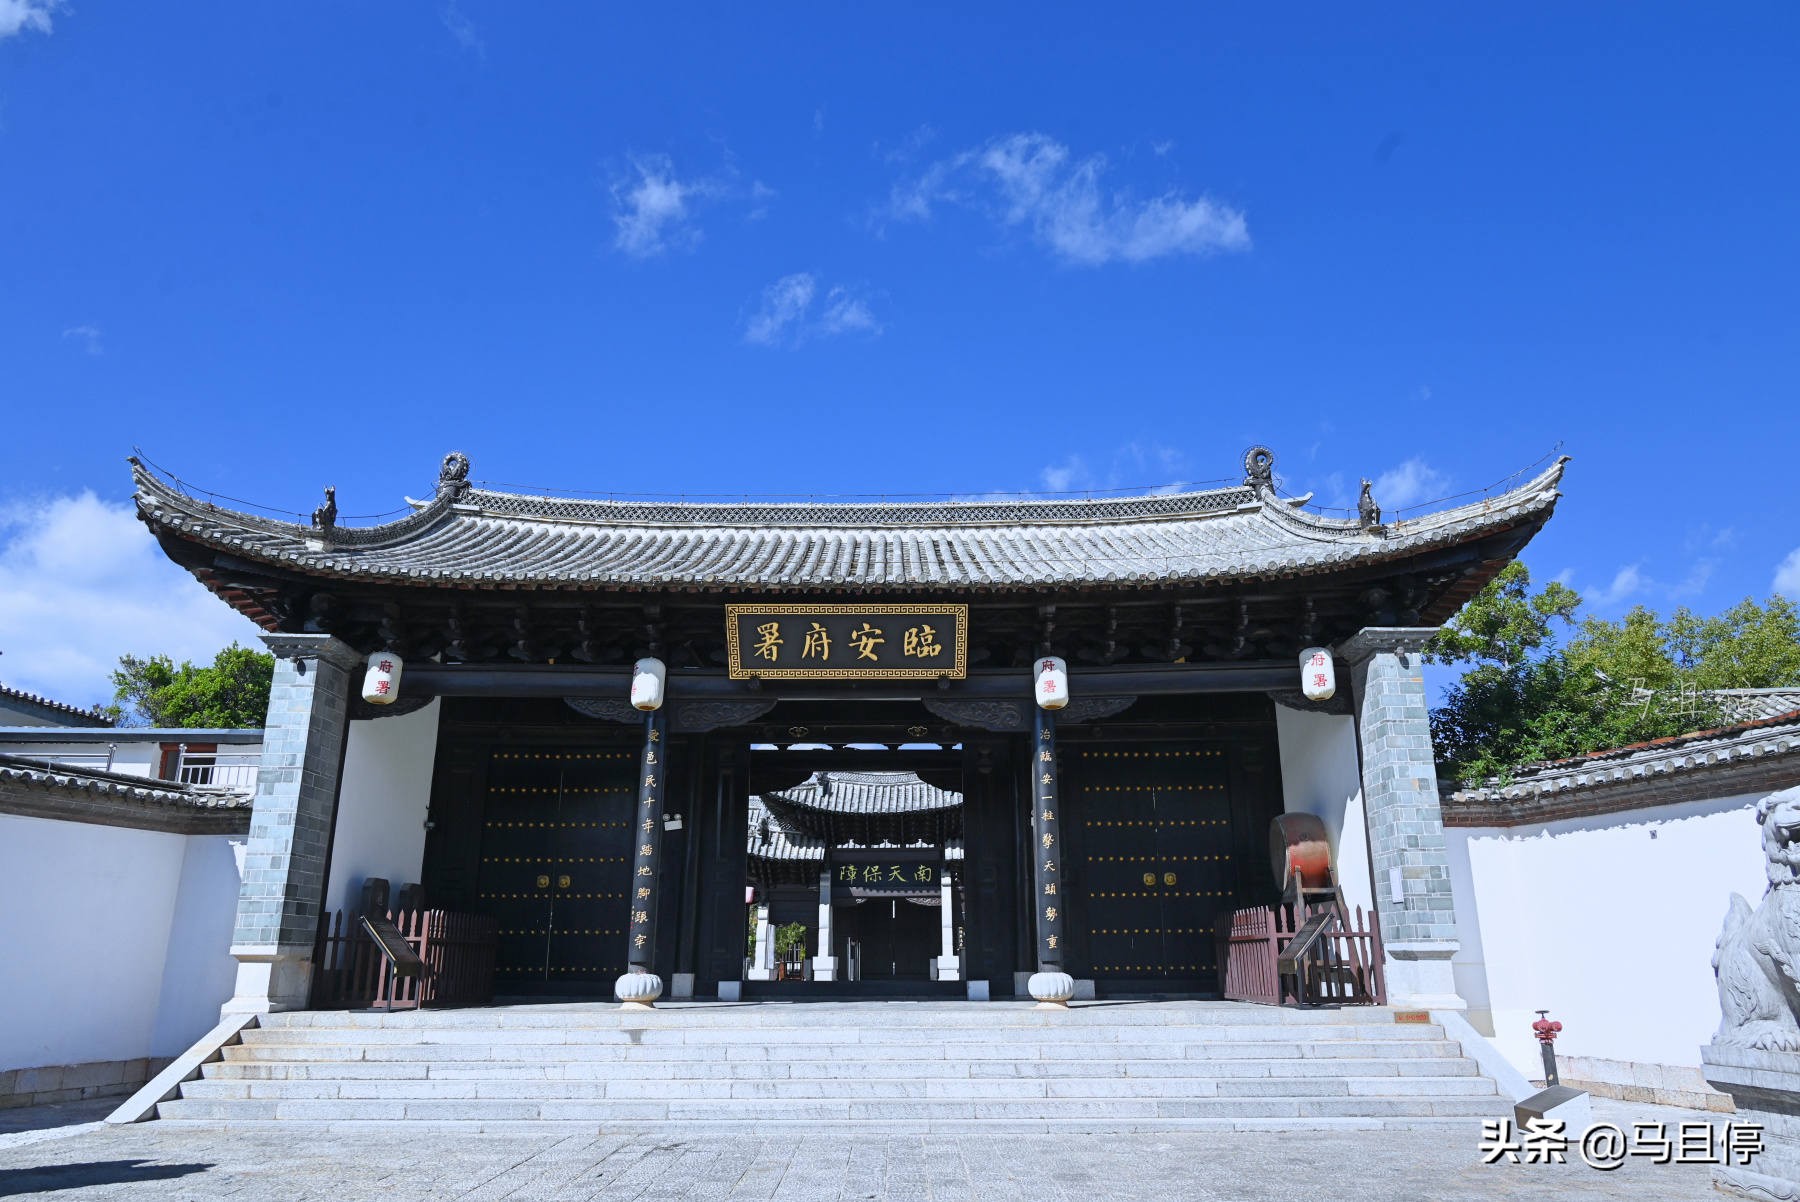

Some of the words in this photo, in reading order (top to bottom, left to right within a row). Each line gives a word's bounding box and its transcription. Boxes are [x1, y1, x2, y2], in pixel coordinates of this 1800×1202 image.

[753, 621, 942, 662] 臨安府署
[376, 659, 394, 695] 府署
[1041, 659, 1057, 694] 府署
[1311, 652, 1328, 688] 府署
[1040, 728, 1059, 950] 治臨安一柱擎天頭勢重
[840, 864, 932, 885] 南天保障
